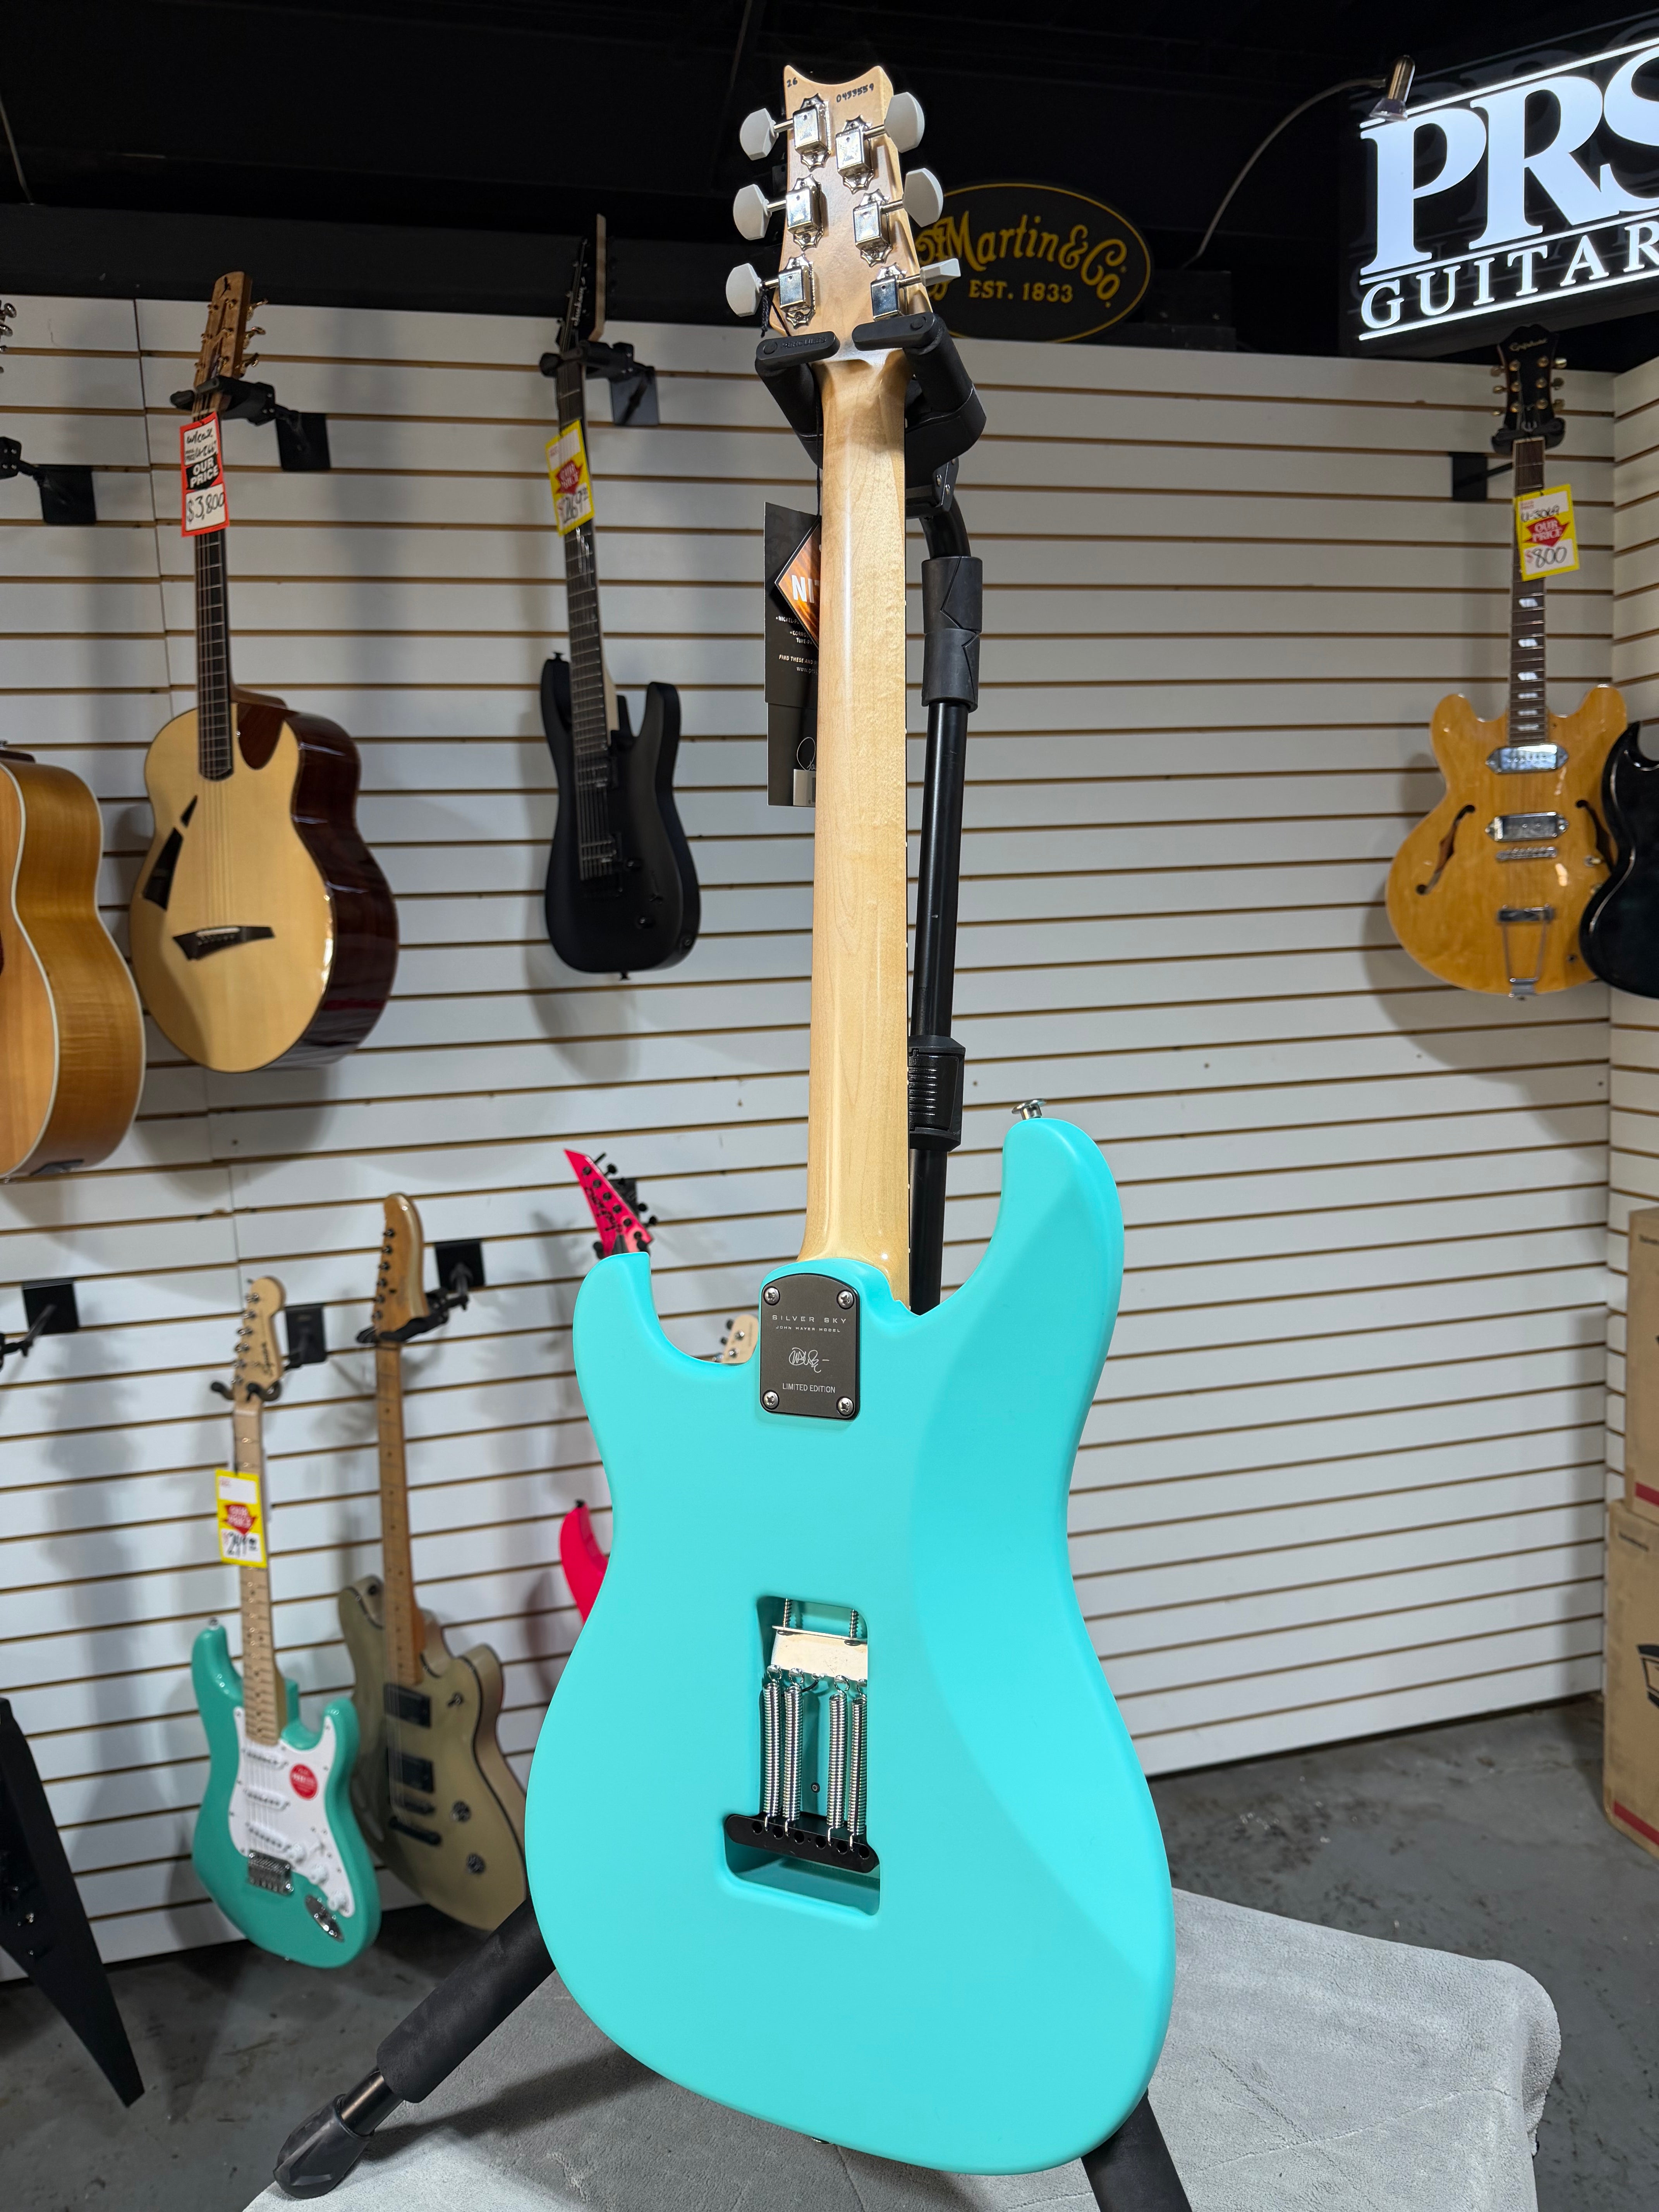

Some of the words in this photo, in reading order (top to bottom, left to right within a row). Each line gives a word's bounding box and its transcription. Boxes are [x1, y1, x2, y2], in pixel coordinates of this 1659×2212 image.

[787, 77, 798, 88] 26
[969, 280, 1013, 300] EST.
[1023, 282, 1073, 303] 1833
[193, 457, 215, 476] OUR
[190, 466, 219, 488] PRICE
[187, 492, 225, 522] $3,800
[1534, 519, 1558, 533] OUR
[1532, 528, 1563, 542] PRICE
[782, 1382, 808, 1391] LIMITED
[809, 1384, 836, 1393] EDITION
